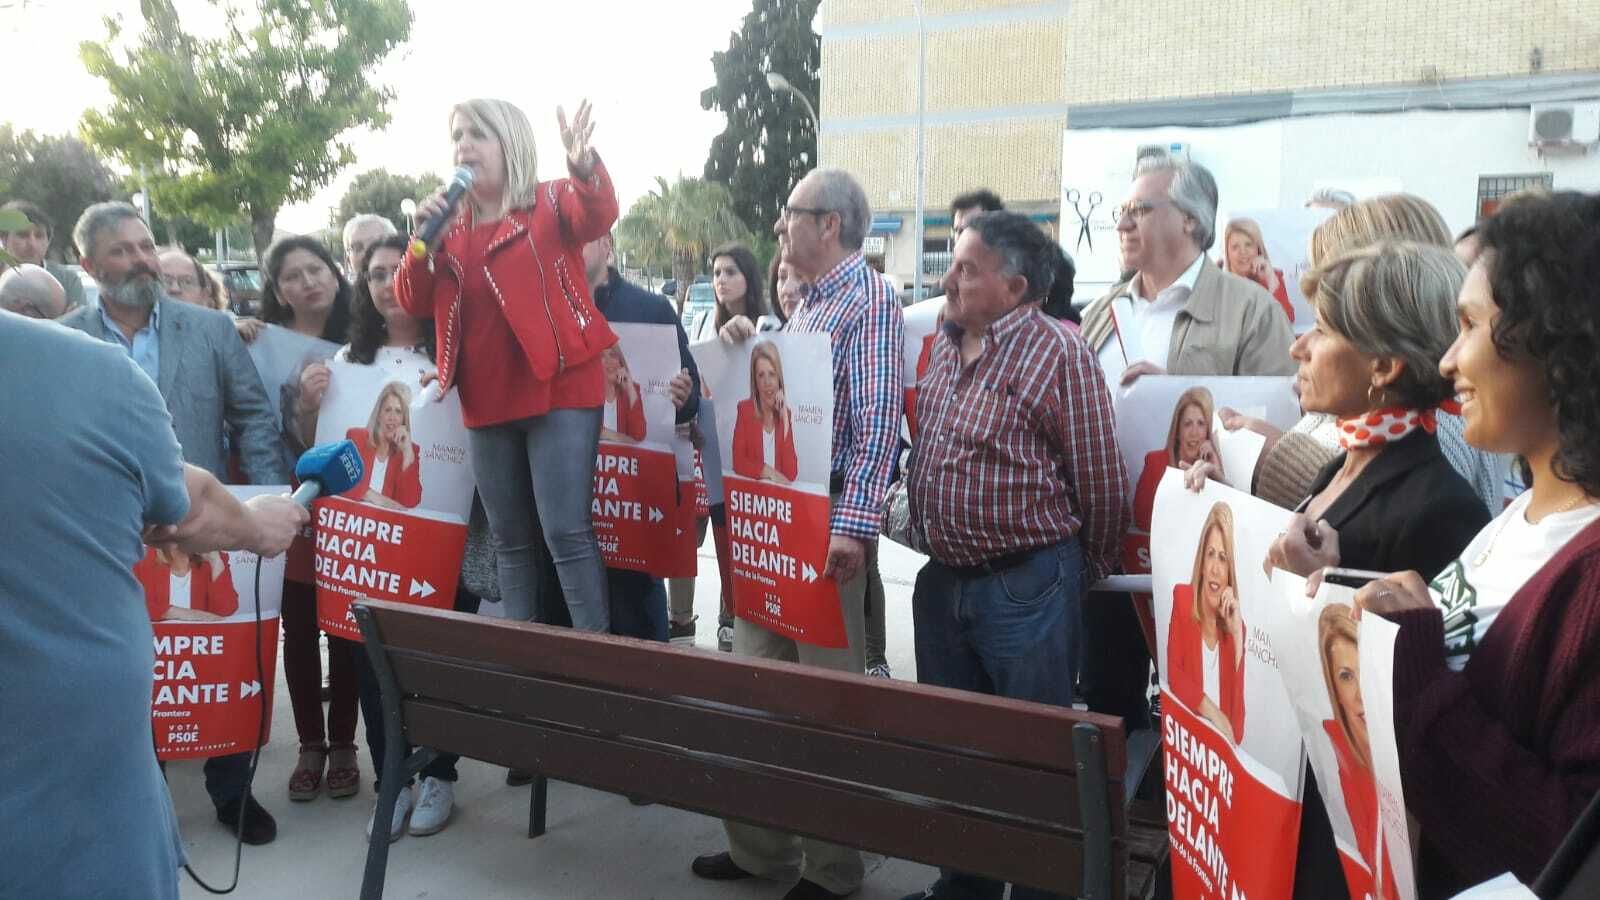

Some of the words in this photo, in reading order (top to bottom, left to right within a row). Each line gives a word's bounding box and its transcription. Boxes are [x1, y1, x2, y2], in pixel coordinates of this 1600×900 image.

[591, 497, 641, 521] ANTE
[730, 490, 792, 524] SIEMPRE
[318, 506, 404, 545] SIEMPRE
[731, 515, 780, 547] HACIA
[316, 530, 377, 564] HACIA
[732, 540, 797, 579] DELANTE
[315, 553, 401, 594] DELANTE
[765, 601, 782, 617] PSOE
[152, 635, 225, 656] MPRE
[152, 660, 198, 681] CIA
[154, 683, 229, 705] ANTE
[153, 710, 192, 718] Frontera
[168, 723, 200, 731] VOTA
[168, 731, 199, 744] PSOE
[1165, 714, 1234, 810] SIEMPRE
[1166, 751, 1220, 835] HACIA
[1166, 790, 1229, 900] DELANTE
